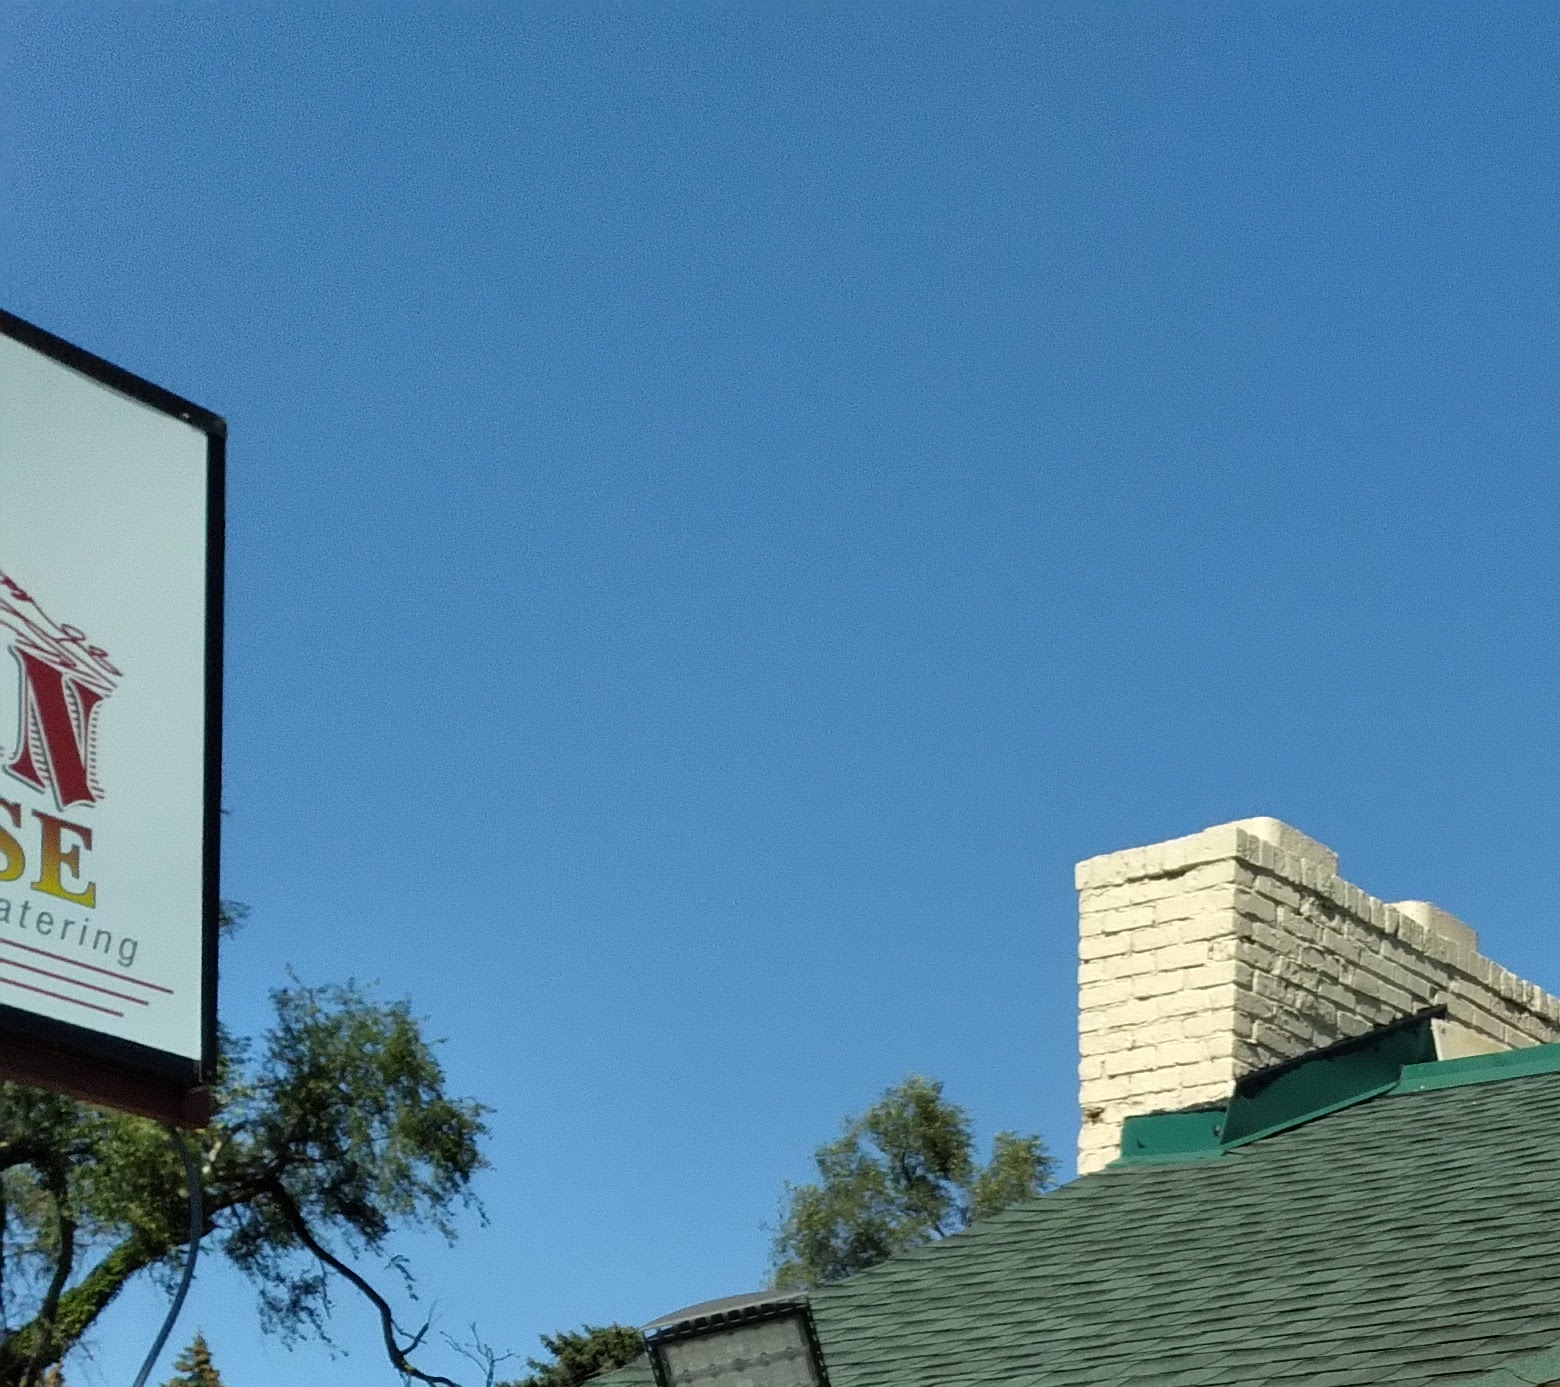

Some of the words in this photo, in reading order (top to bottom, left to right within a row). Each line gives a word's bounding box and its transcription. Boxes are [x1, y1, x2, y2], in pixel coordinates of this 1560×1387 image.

[3, 646, 105, 811] N
[0, 797, 97, 909] SE
[0, 896, 138, 967] atering
